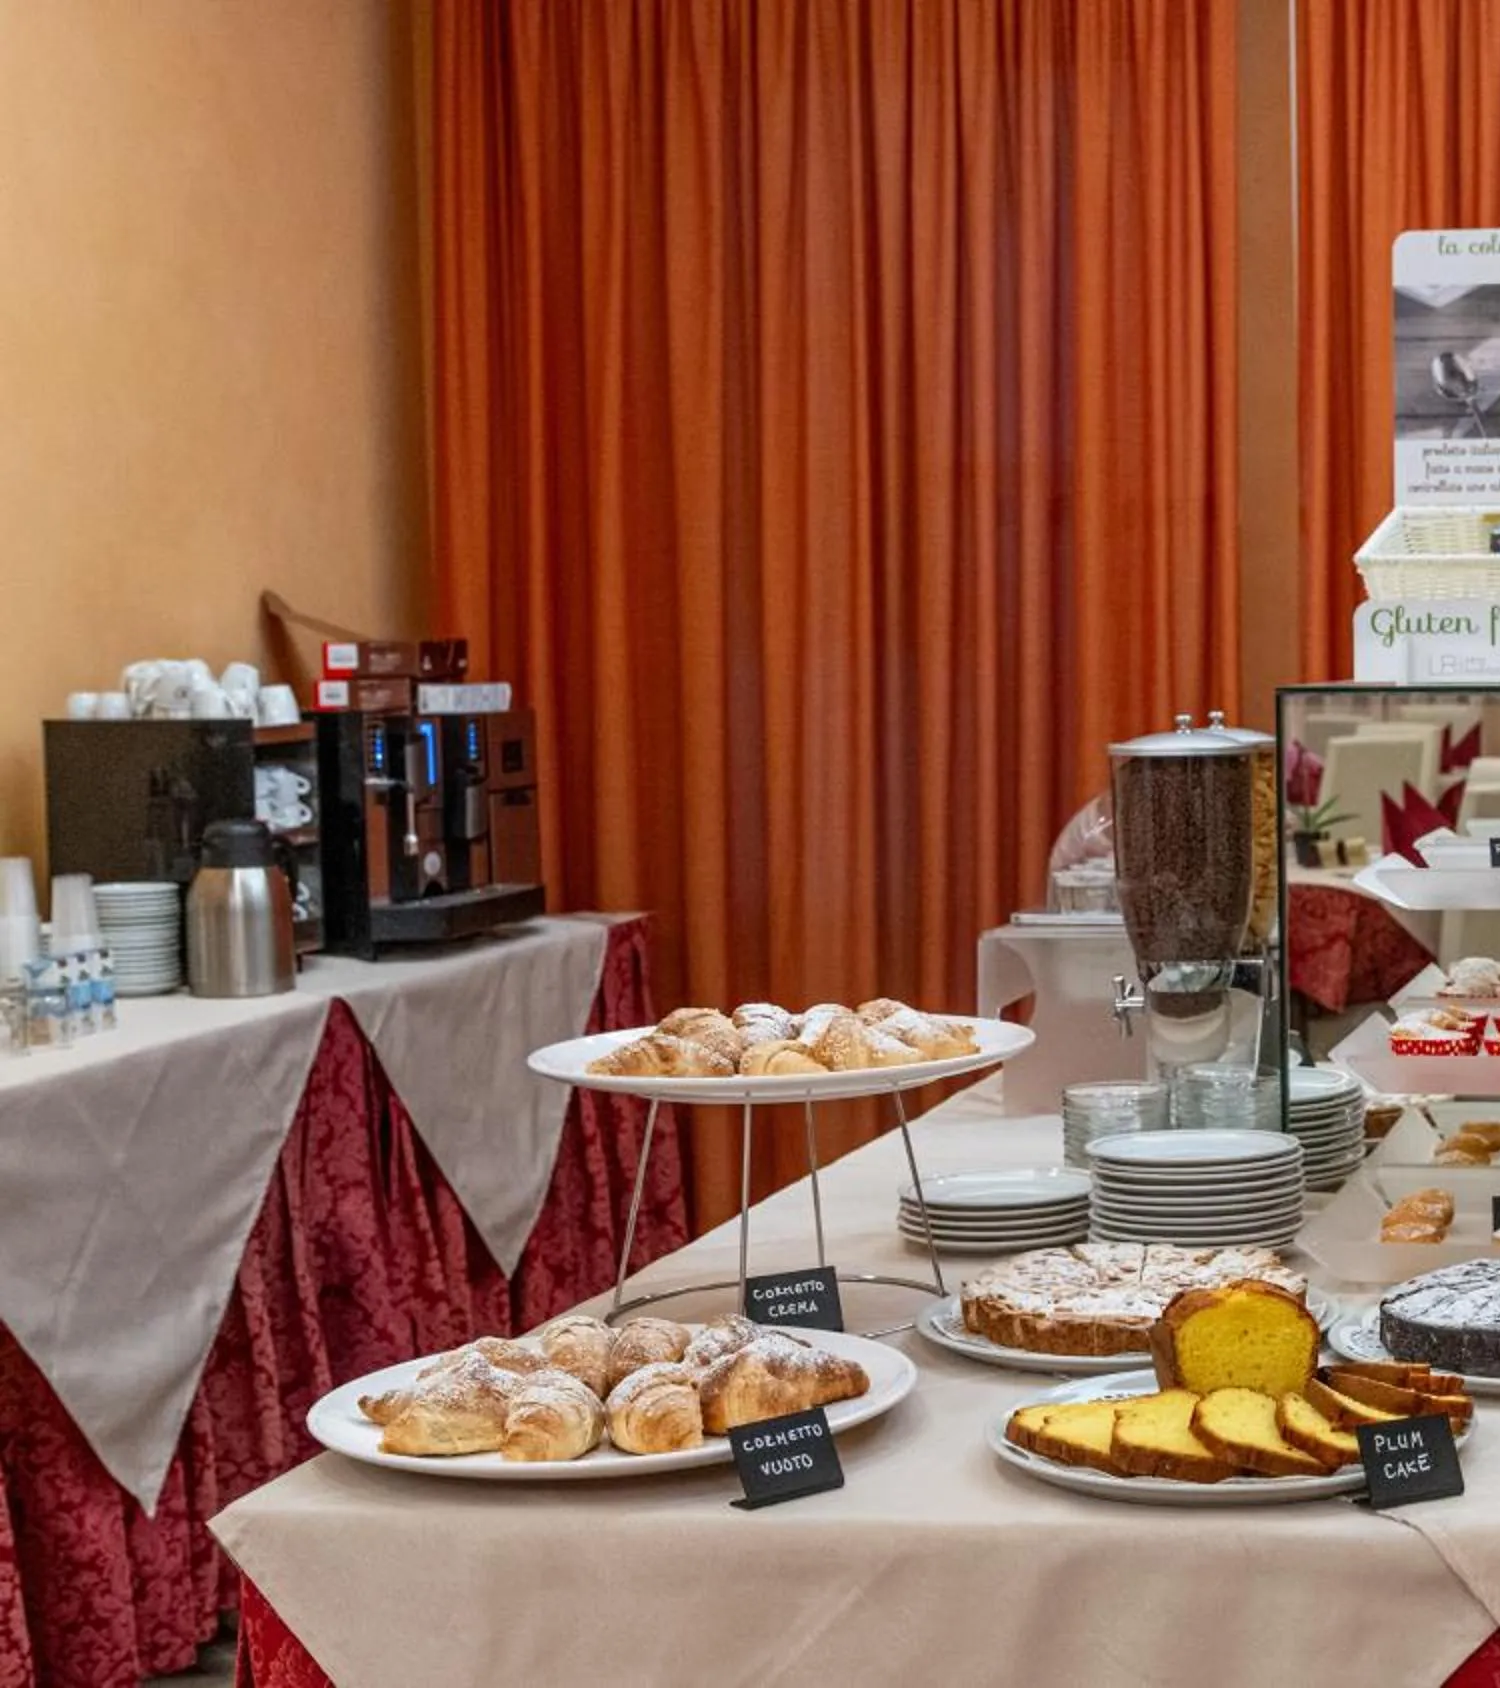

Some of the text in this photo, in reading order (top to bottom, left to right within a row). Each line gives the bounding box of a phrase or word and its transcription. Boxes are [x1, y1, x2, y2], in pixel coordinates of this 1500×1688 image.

[1437, 235, 1460, 256] la
[1370, 605, 1480, 648] Gluten
[753, 1280, 825, 1300] CORNETTO
[768, 1299, 819, 1318] CREMA
[743, 1423, 823, 1451] CORNETTO
[1374, 1431, 1424, 1452] PLUM
[761, 1453, 814, 1475] VUOTO
[1383, 1453, 1432, 1479] CAKE
